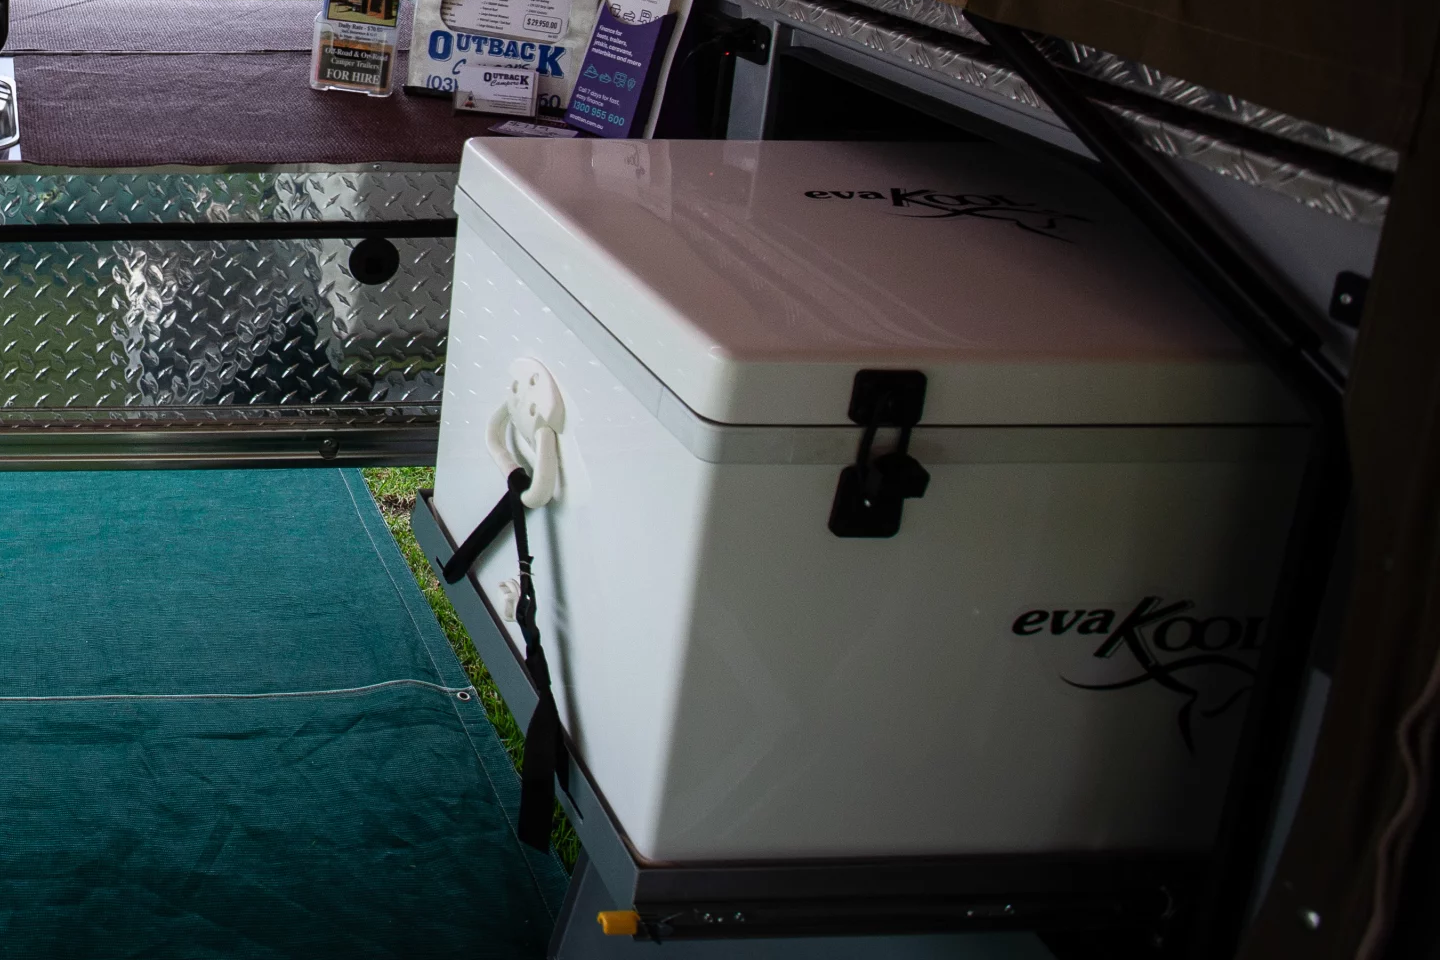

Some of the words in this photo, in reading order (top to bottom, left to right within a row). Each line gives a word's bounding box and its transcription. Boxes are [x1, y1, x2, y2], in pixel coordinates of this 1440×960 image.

[599, 25, 615, 35] Finance
[597, 32, 609, 41] boats,
[609, 36, 627, 47] trailers,
[325, 47, 353, 57] Off-Road
[360, 53, 388, 62] On-Road
[428, 30, 566, 79] OUTBACK
[591, 47, 617, 60] motorbikes
[616, 55, 627, 63] and
[627, 58, 642, 67] more
[609, 44, 633, 57] caravans,
[331, 57, 355, 67] Camper
[356, 60, 380, 70] Trailers
[326, 68, 350, 80] FOR
[352, 71, 381, 85] HIRE
[426, 74, 458, 92] (03)
[483, 72, 529, 86] OUTBACK
[575, 92, 586, 102] easy
[586, 96, 604, 107] finance
[590, 89, 601, 99] days
[609, 97, 620, 106] fast,
[573, 100, 590, 113] 1300
[591, 108, 607, 120] 955
[608, 114, 625, 126] 600
[569, 113, 604, 130] stratton.com.au
